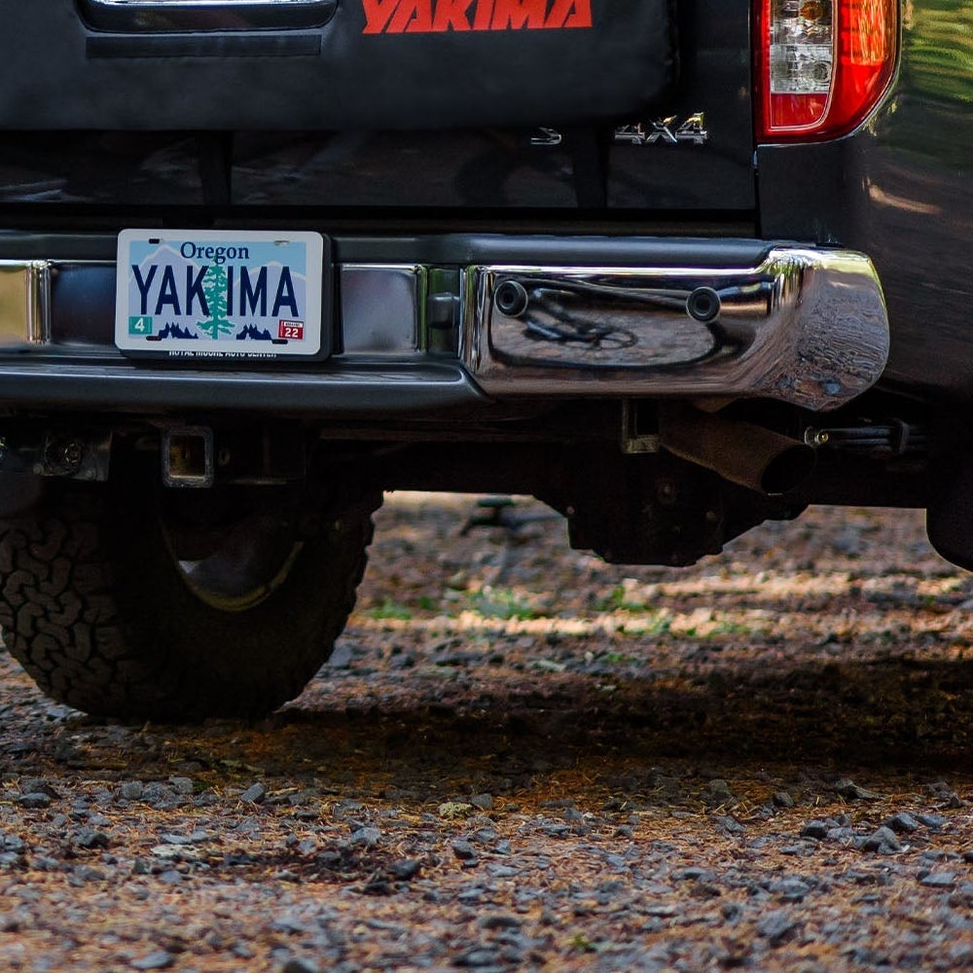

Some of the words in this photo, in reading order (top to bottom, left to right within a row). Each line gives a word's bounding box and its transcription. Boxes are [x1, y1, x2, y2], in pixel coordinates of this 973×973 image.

[180, 241, 250, 264] Oregon
[131, 264, 300, 318] YAKIMA
[134, 318, 145, 332] 4
[284, 327, 299, 338] 22
